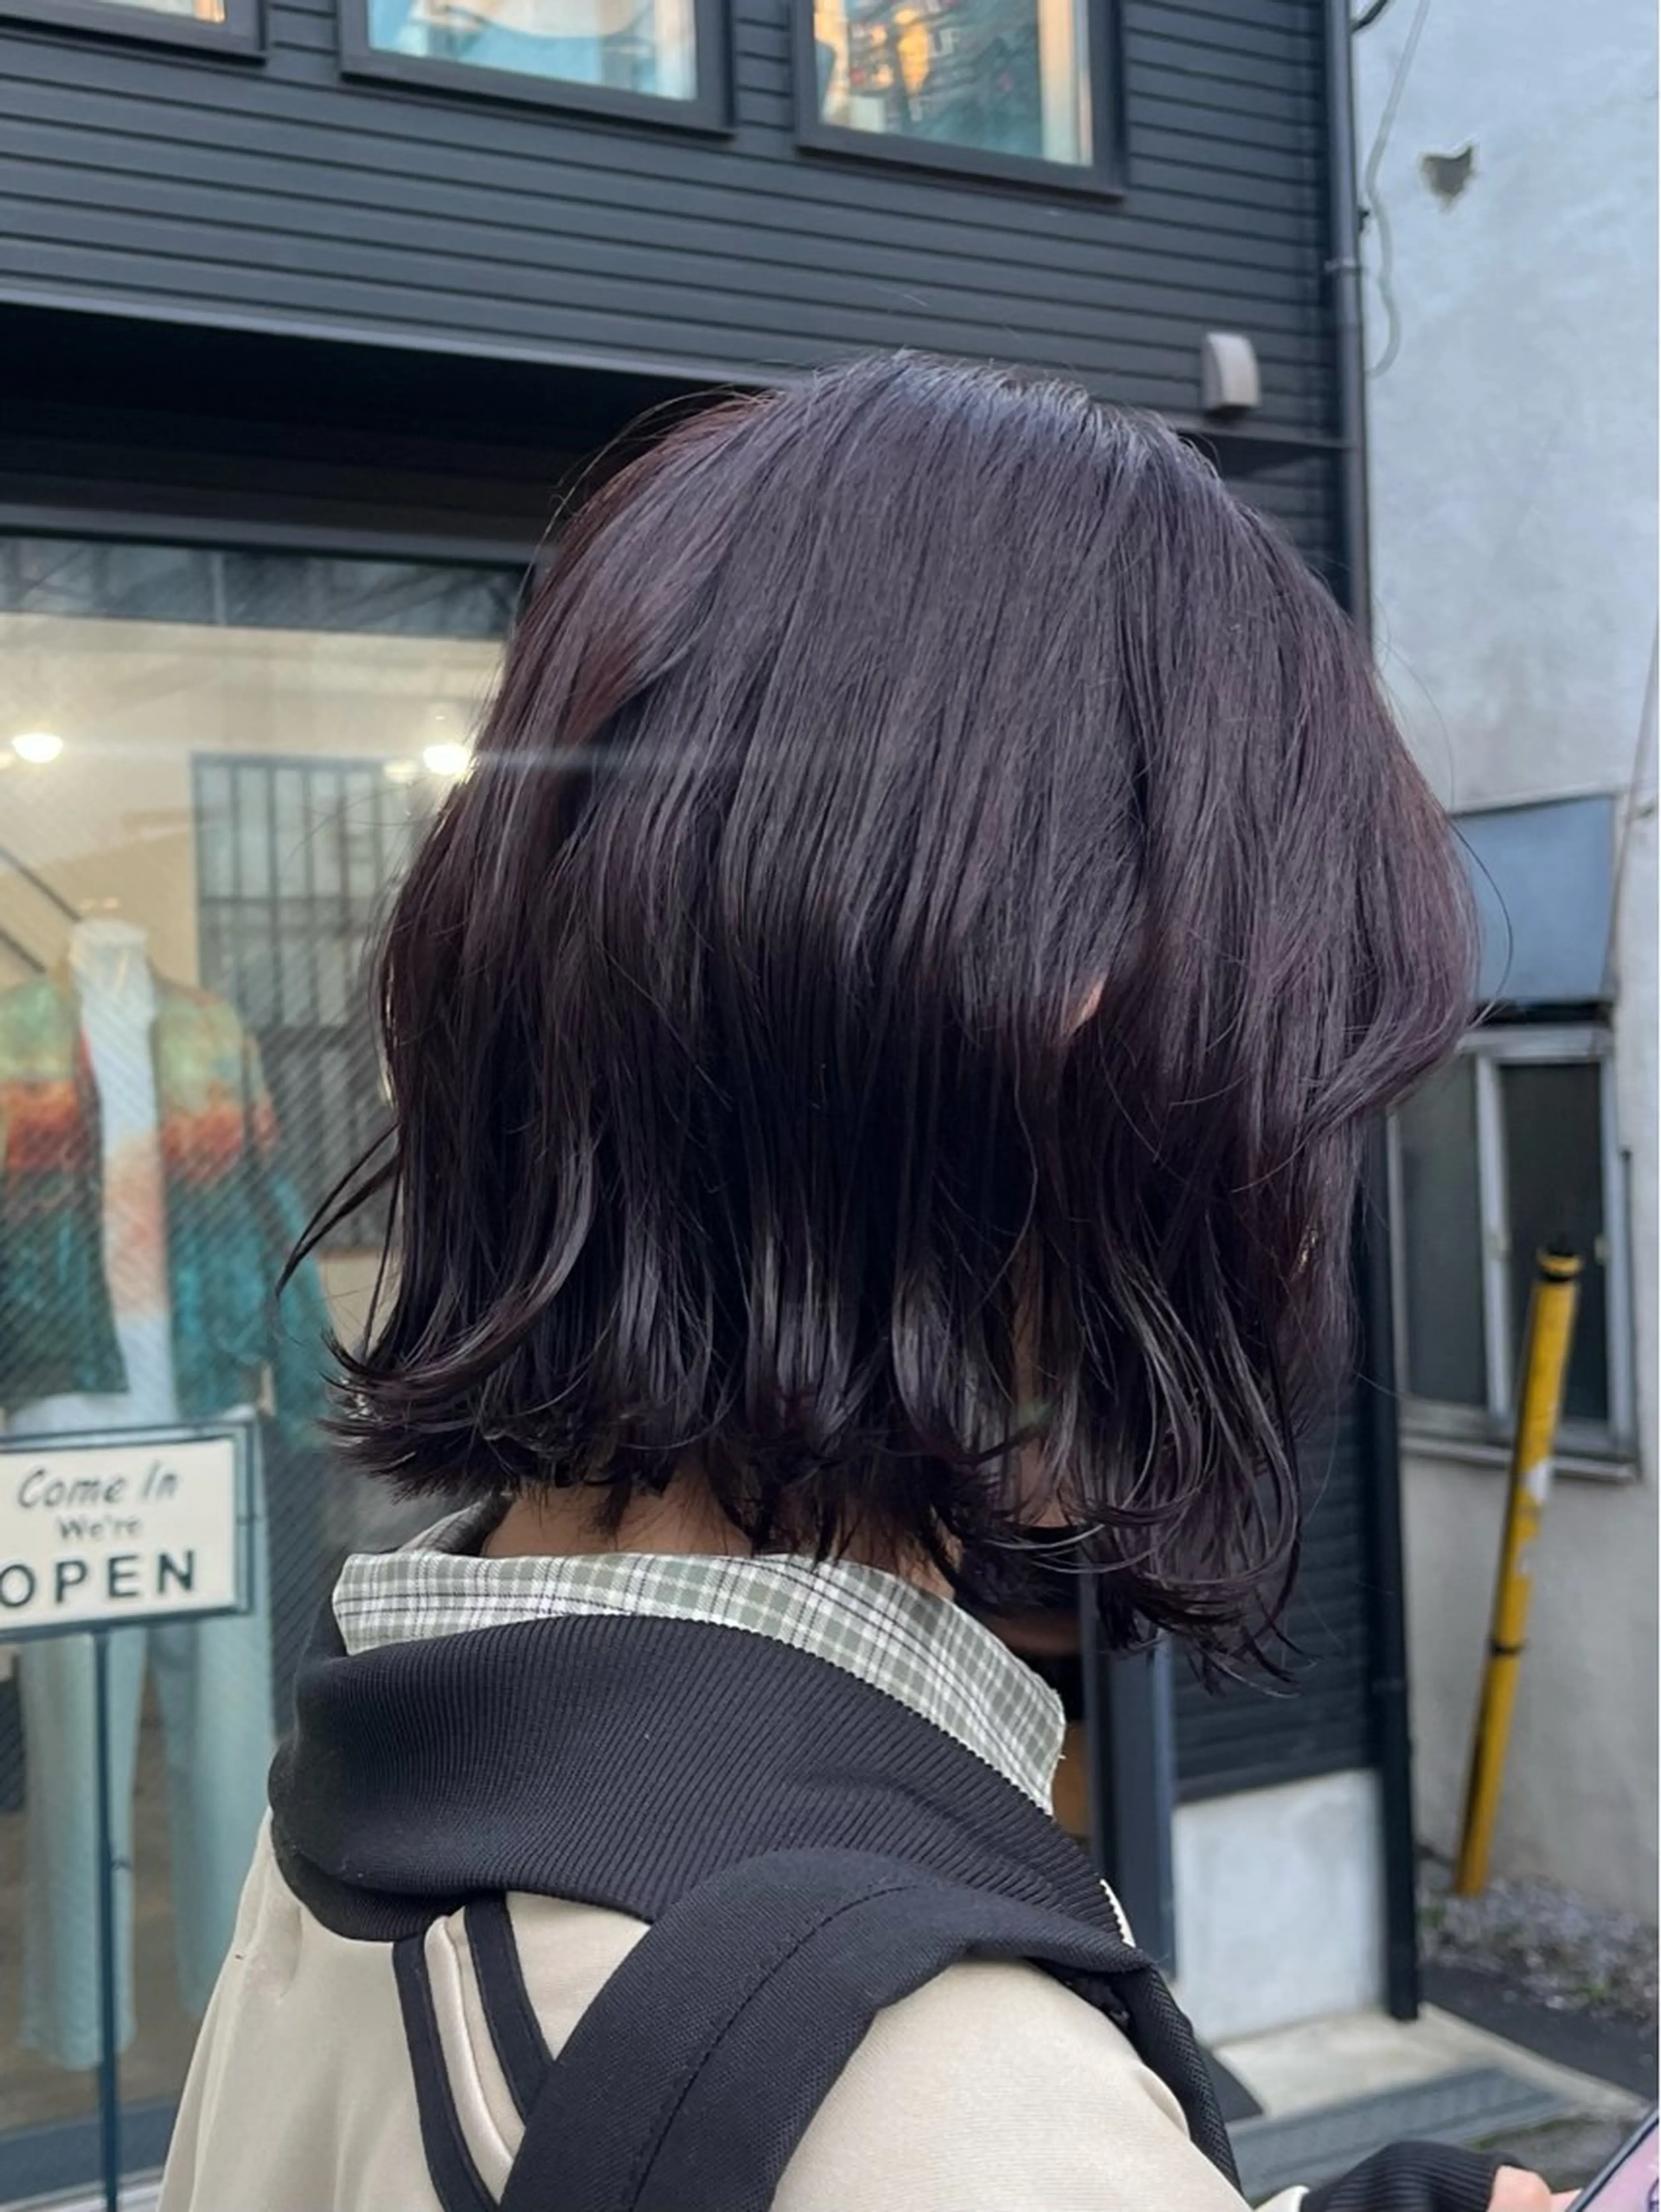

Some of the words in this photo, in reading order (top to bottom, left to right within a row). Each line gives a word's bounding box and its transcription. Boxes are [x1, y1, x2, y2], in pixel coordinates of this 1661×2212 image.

[17, 1467, 127, 1509] Come
[142, 1460, 177, 1502] In
[58, 1515, 140, 1540] We're
[0, 1549, 194, 1607] OPEN
